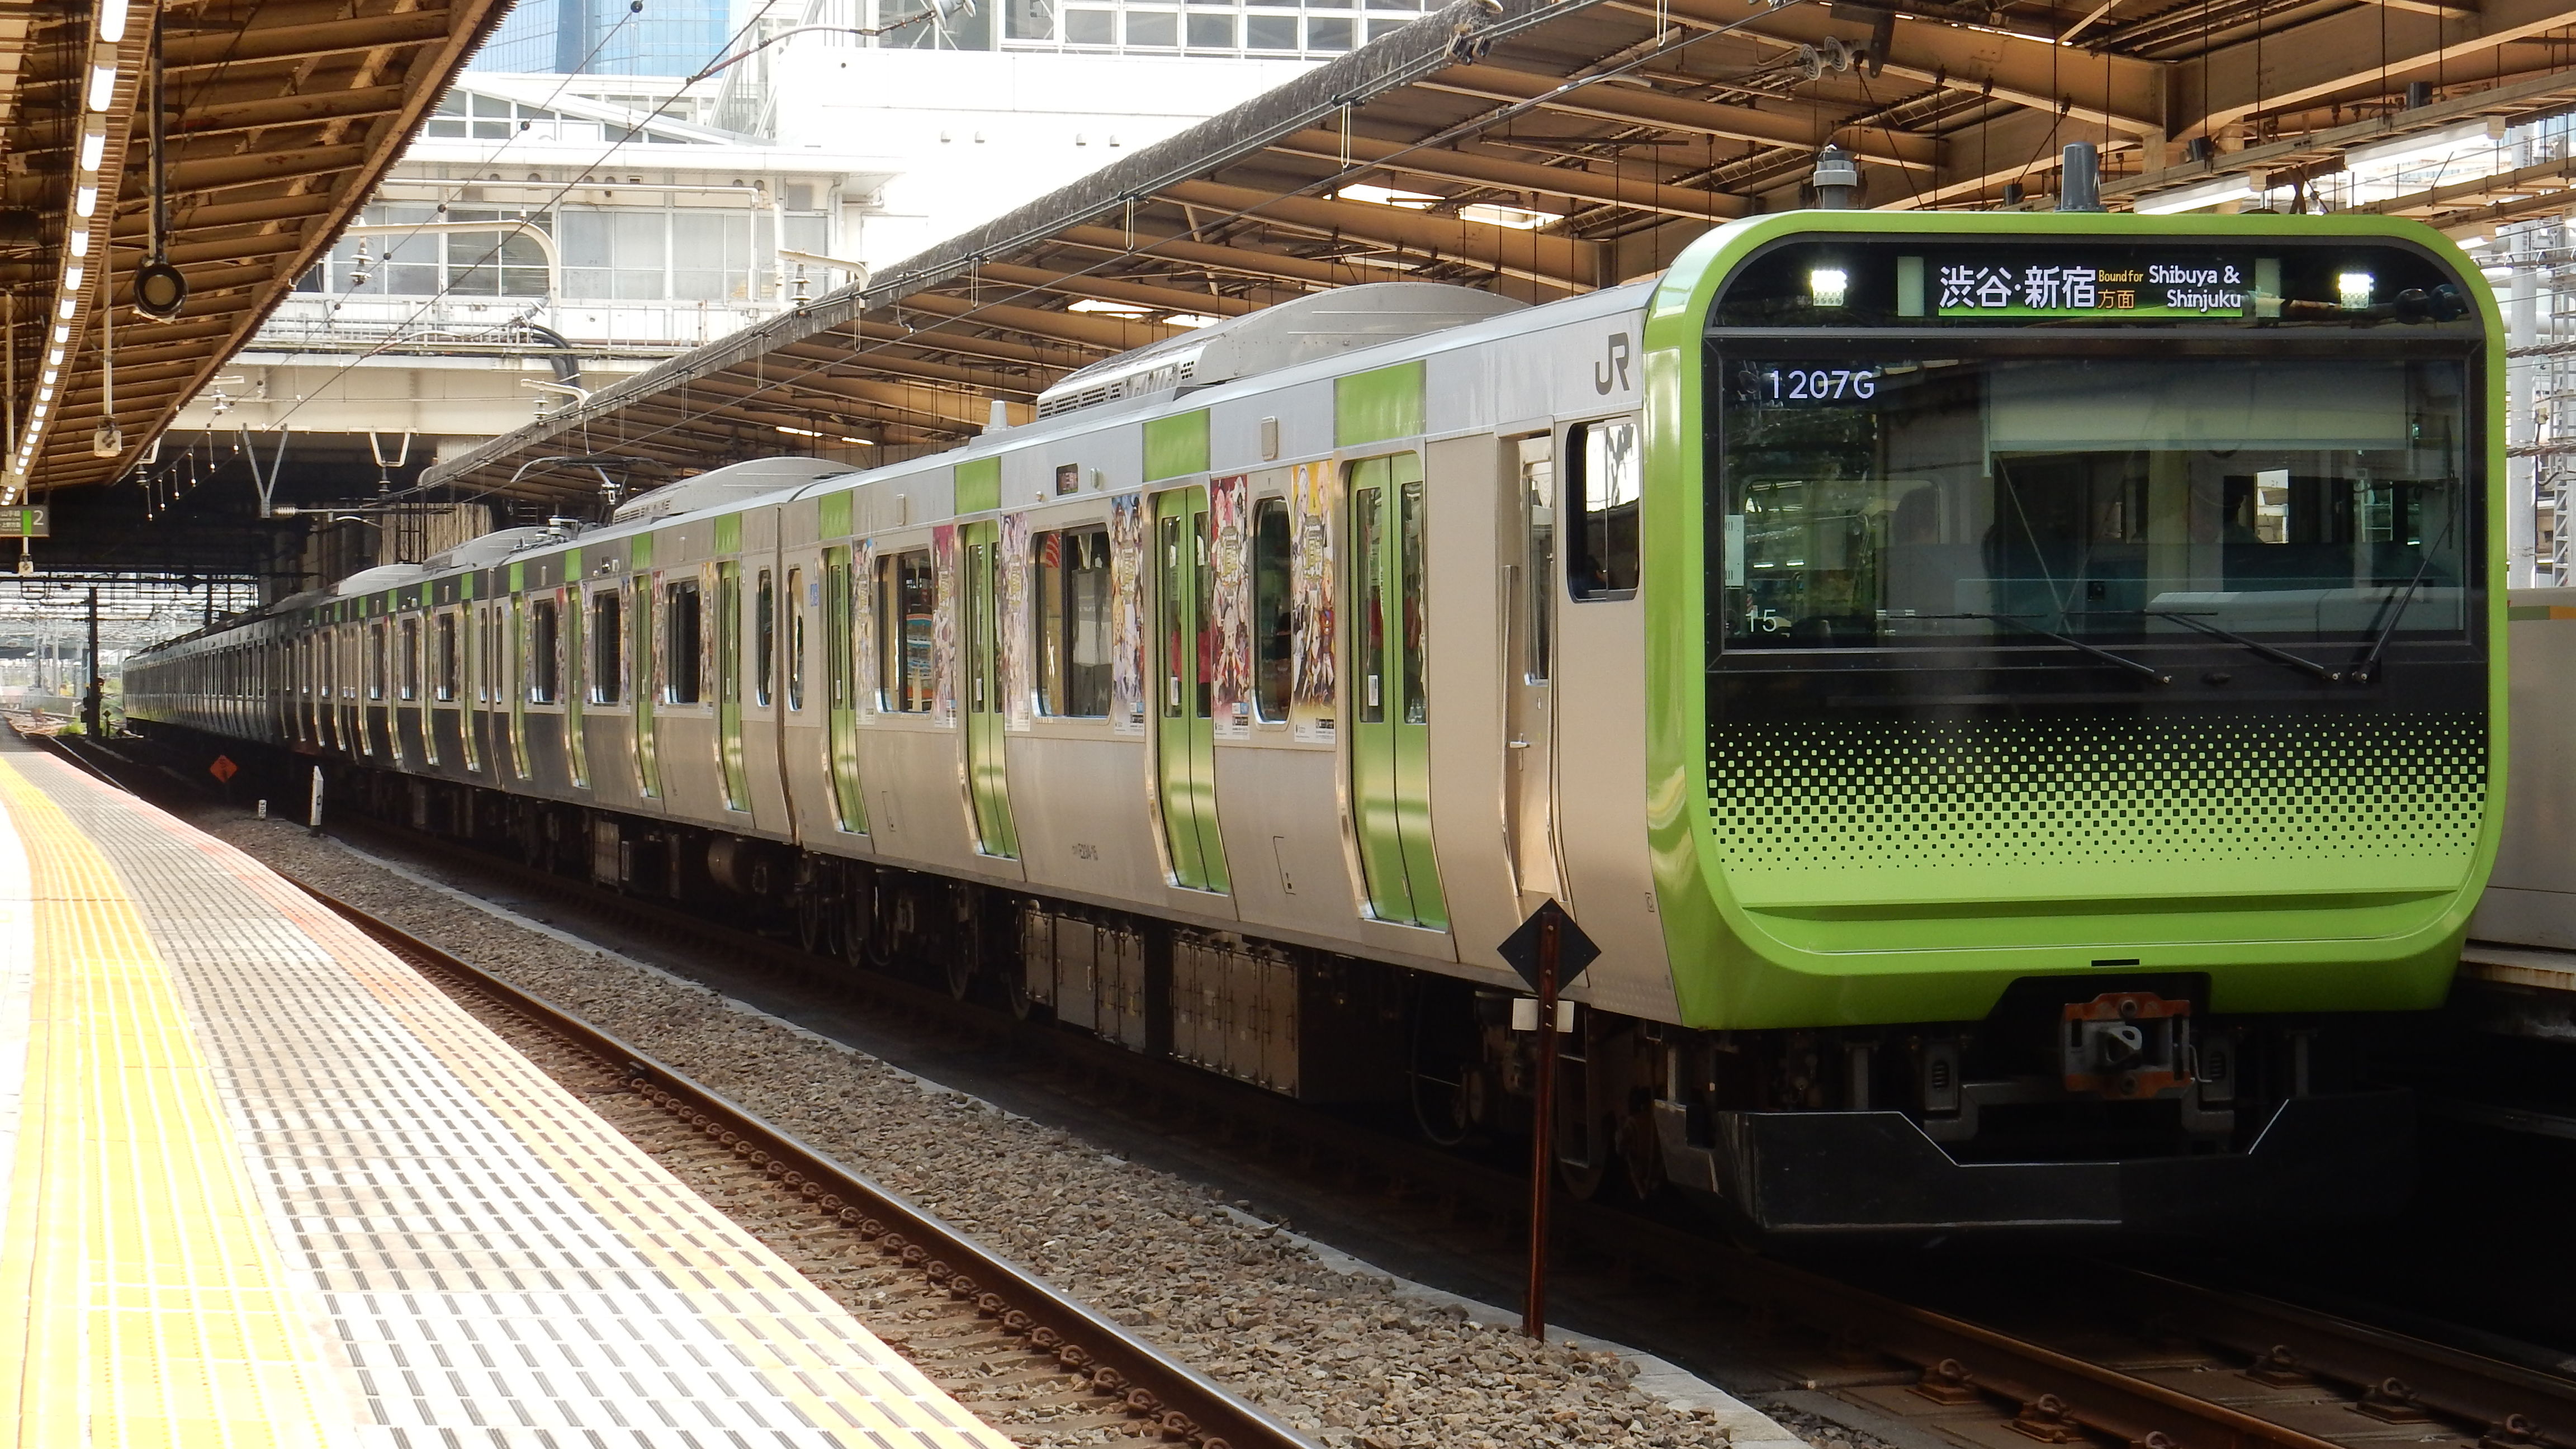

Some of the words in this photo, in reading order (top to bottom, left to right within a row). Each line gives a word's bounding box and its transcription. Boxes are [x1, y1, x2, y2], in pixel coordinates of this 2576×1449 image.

[1939, 265, 2096, 308] 渋谷・新宿
[2099, 269, 2127, 282] Bound
[2128, 269, 2144, 282] for
[2149, 265, 2218, 287] Shibuya
[2223, 265, 2241, 284] &
[2097, 289, 2135, 309] 方面
[2167, 288, 2241, 313] Shinjuku
[1595, 332, 1631, 396] JR
[1771, 370, 1875, 399] 1207G
[34, 510, 44, 525] 2
[1745, 609, 1777, 633] 15
